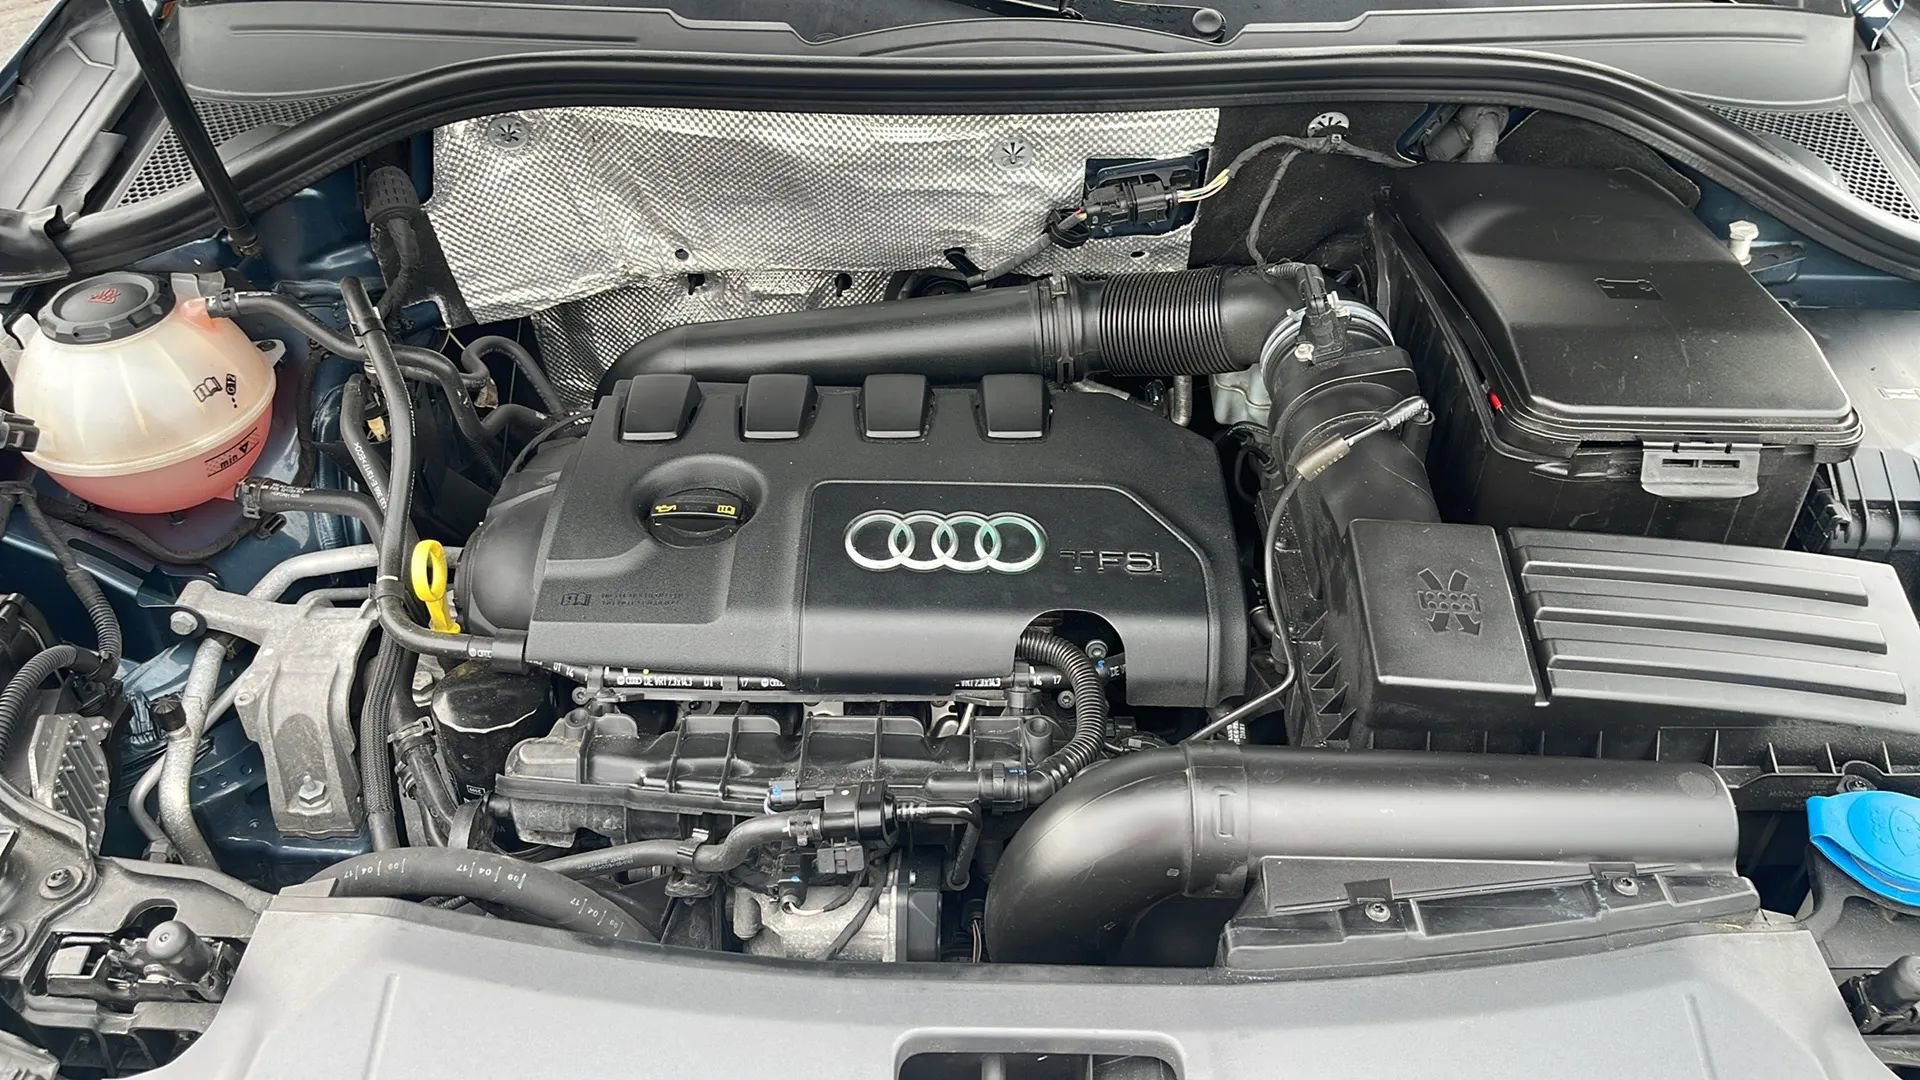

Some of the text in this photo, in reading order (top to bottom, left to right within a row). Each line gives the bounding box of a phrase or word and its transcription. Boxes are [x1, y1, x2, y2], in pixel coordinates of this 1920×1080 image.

[226, 374, 236, 394] G12
[220, 454, 239, 469] min
[1059, 550, 1162, 575] TFSI
[739, 677, 750, 688] 17
[1052, 674, 1062, 685] 17
[455, 863, 468, 872] 17
[478, 867, 492, 876] 04
[343, 869, 354, 879] 17
[569, 897, 580, 906] 17
